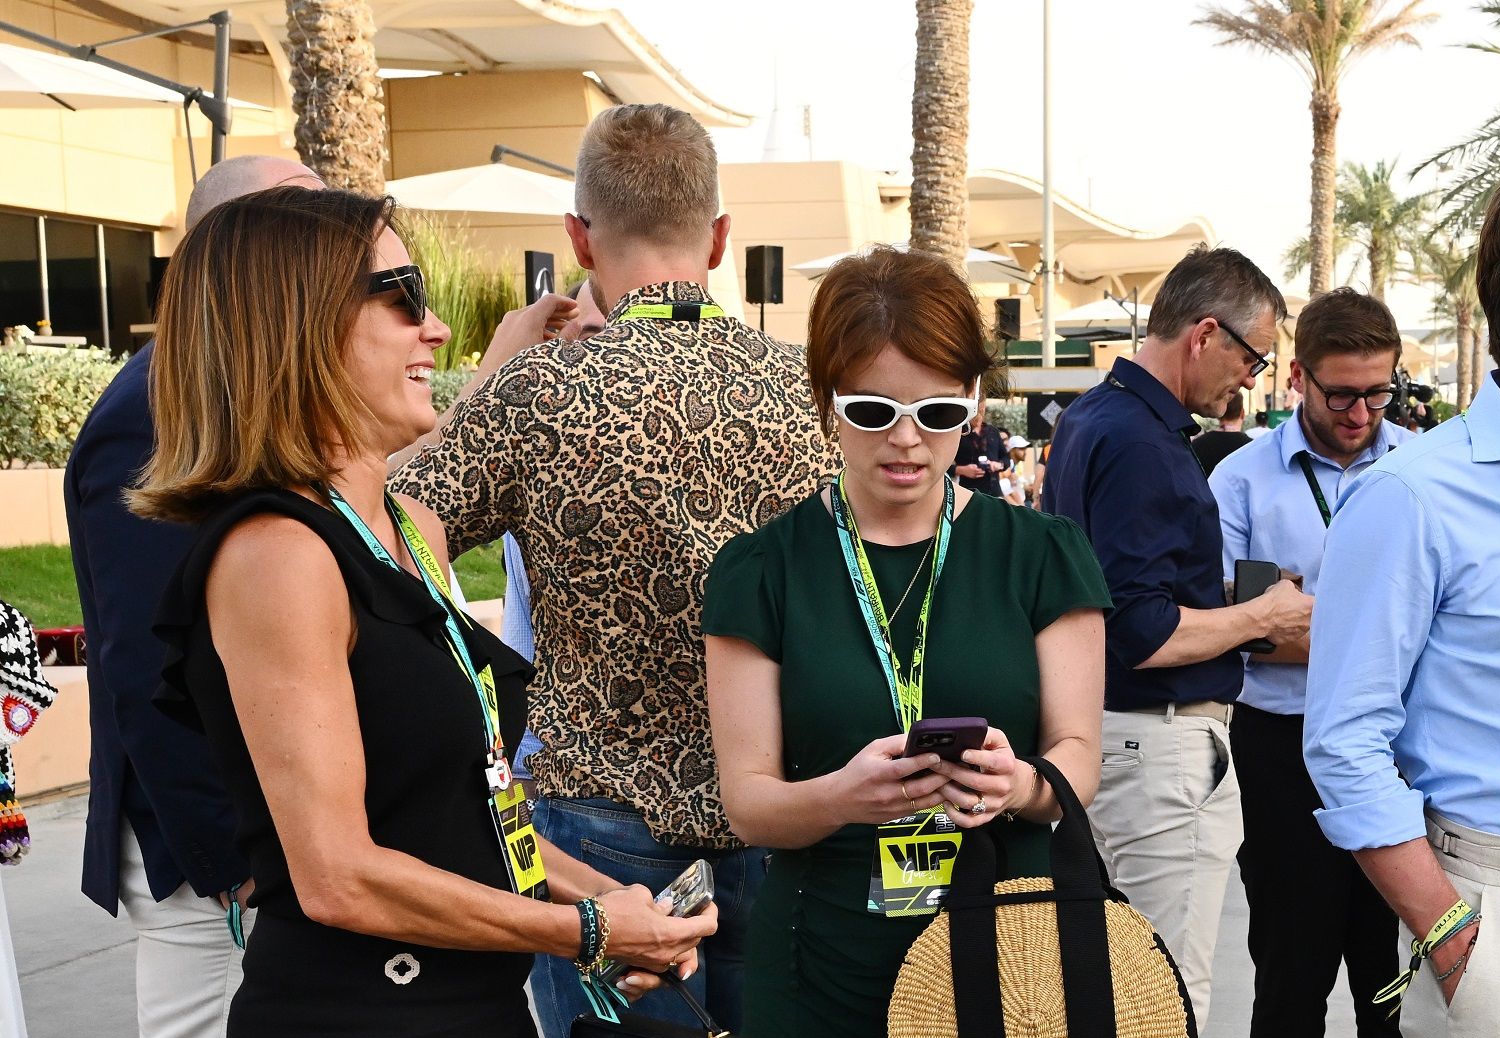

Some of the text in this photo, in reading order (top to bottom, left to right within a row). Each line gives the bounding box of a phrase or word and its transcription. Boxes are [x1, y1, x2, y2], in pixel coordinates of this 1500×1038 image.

[866, 581, 885, 622] BAHRAIN
[510, 834, 536, 872] VIP
[887, 840, 958, 872] VIP
[902, 856, 942, 884] Guest
[1434, 909, 1458, 933] CLUB
